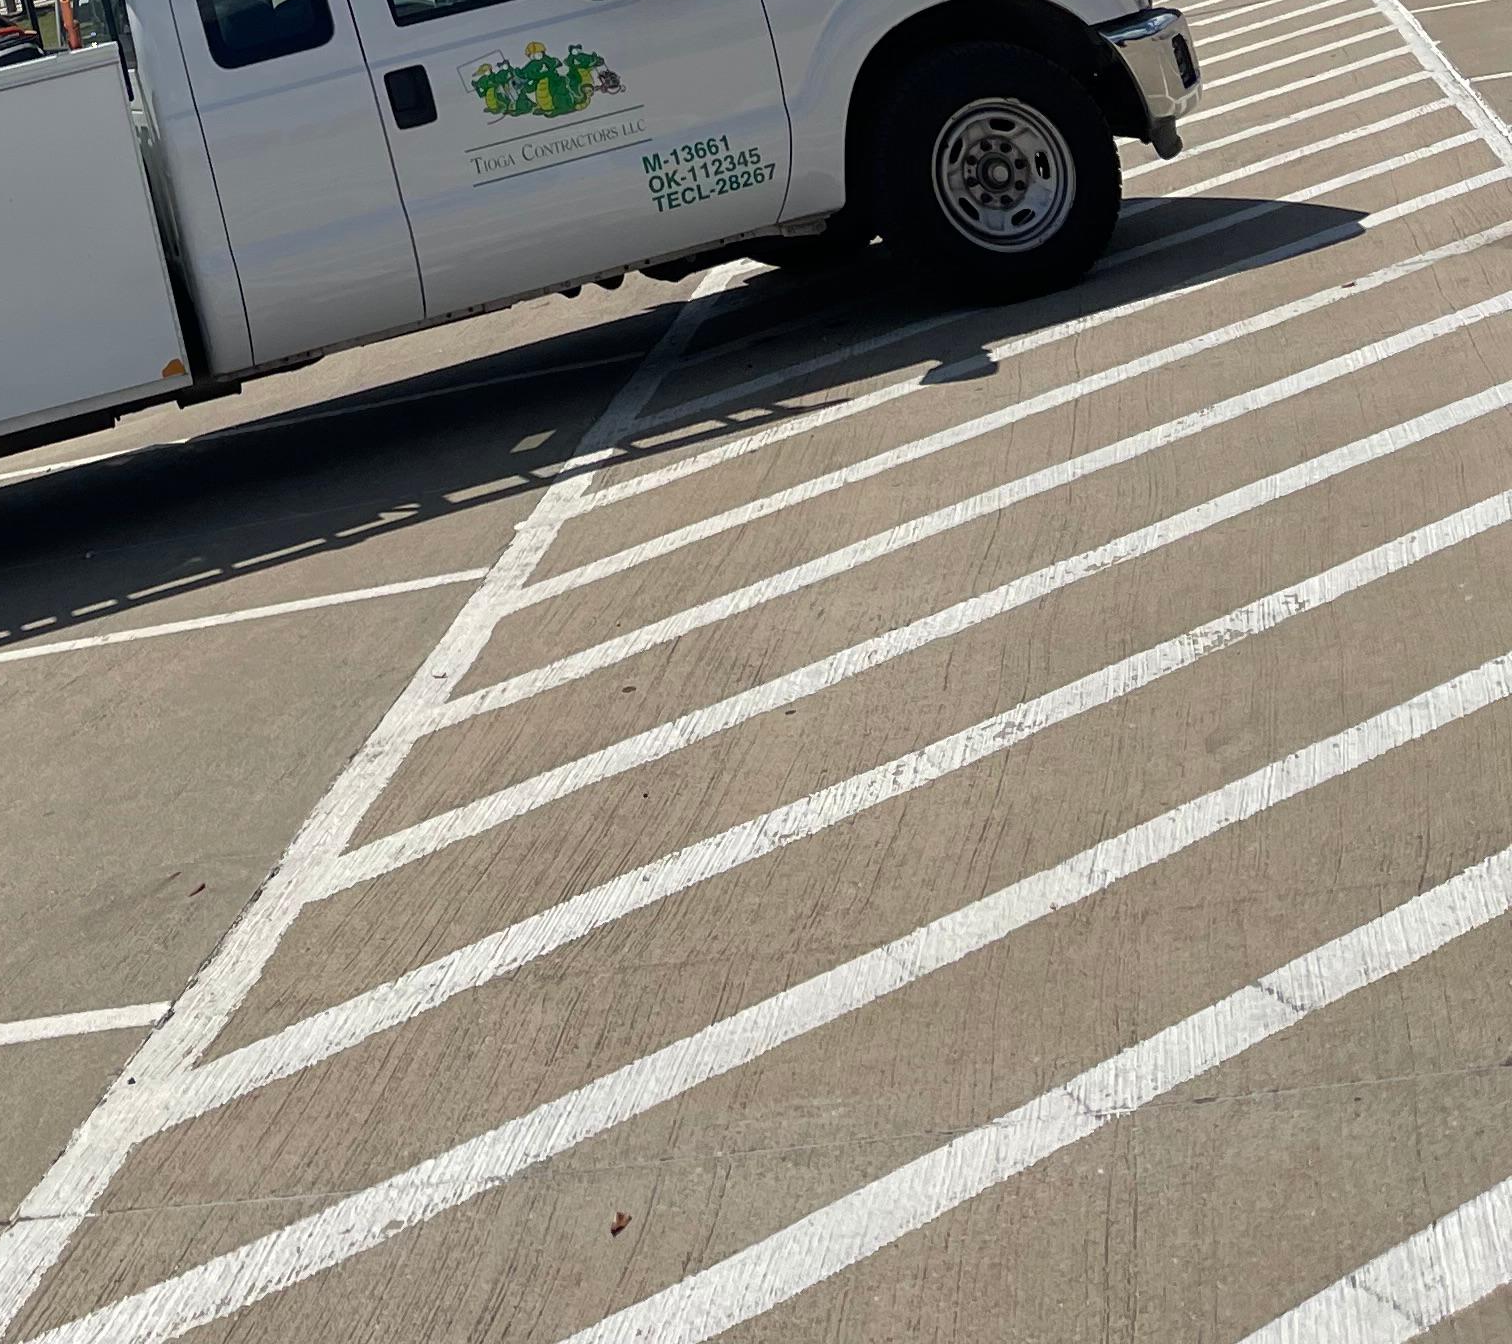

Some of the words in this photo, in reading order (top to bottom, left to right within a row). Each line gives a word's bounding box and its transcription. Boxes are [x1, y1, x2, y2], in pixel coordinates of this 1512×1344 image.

[521, 126, 619, 162] CONTRACTORS
[622, 119, 647, 136] LLC
[642, 135, 730, 174] M-13661
[648, 147, 761, 194] OK-112345
[652, 163, 776, 212] TECL-28267
